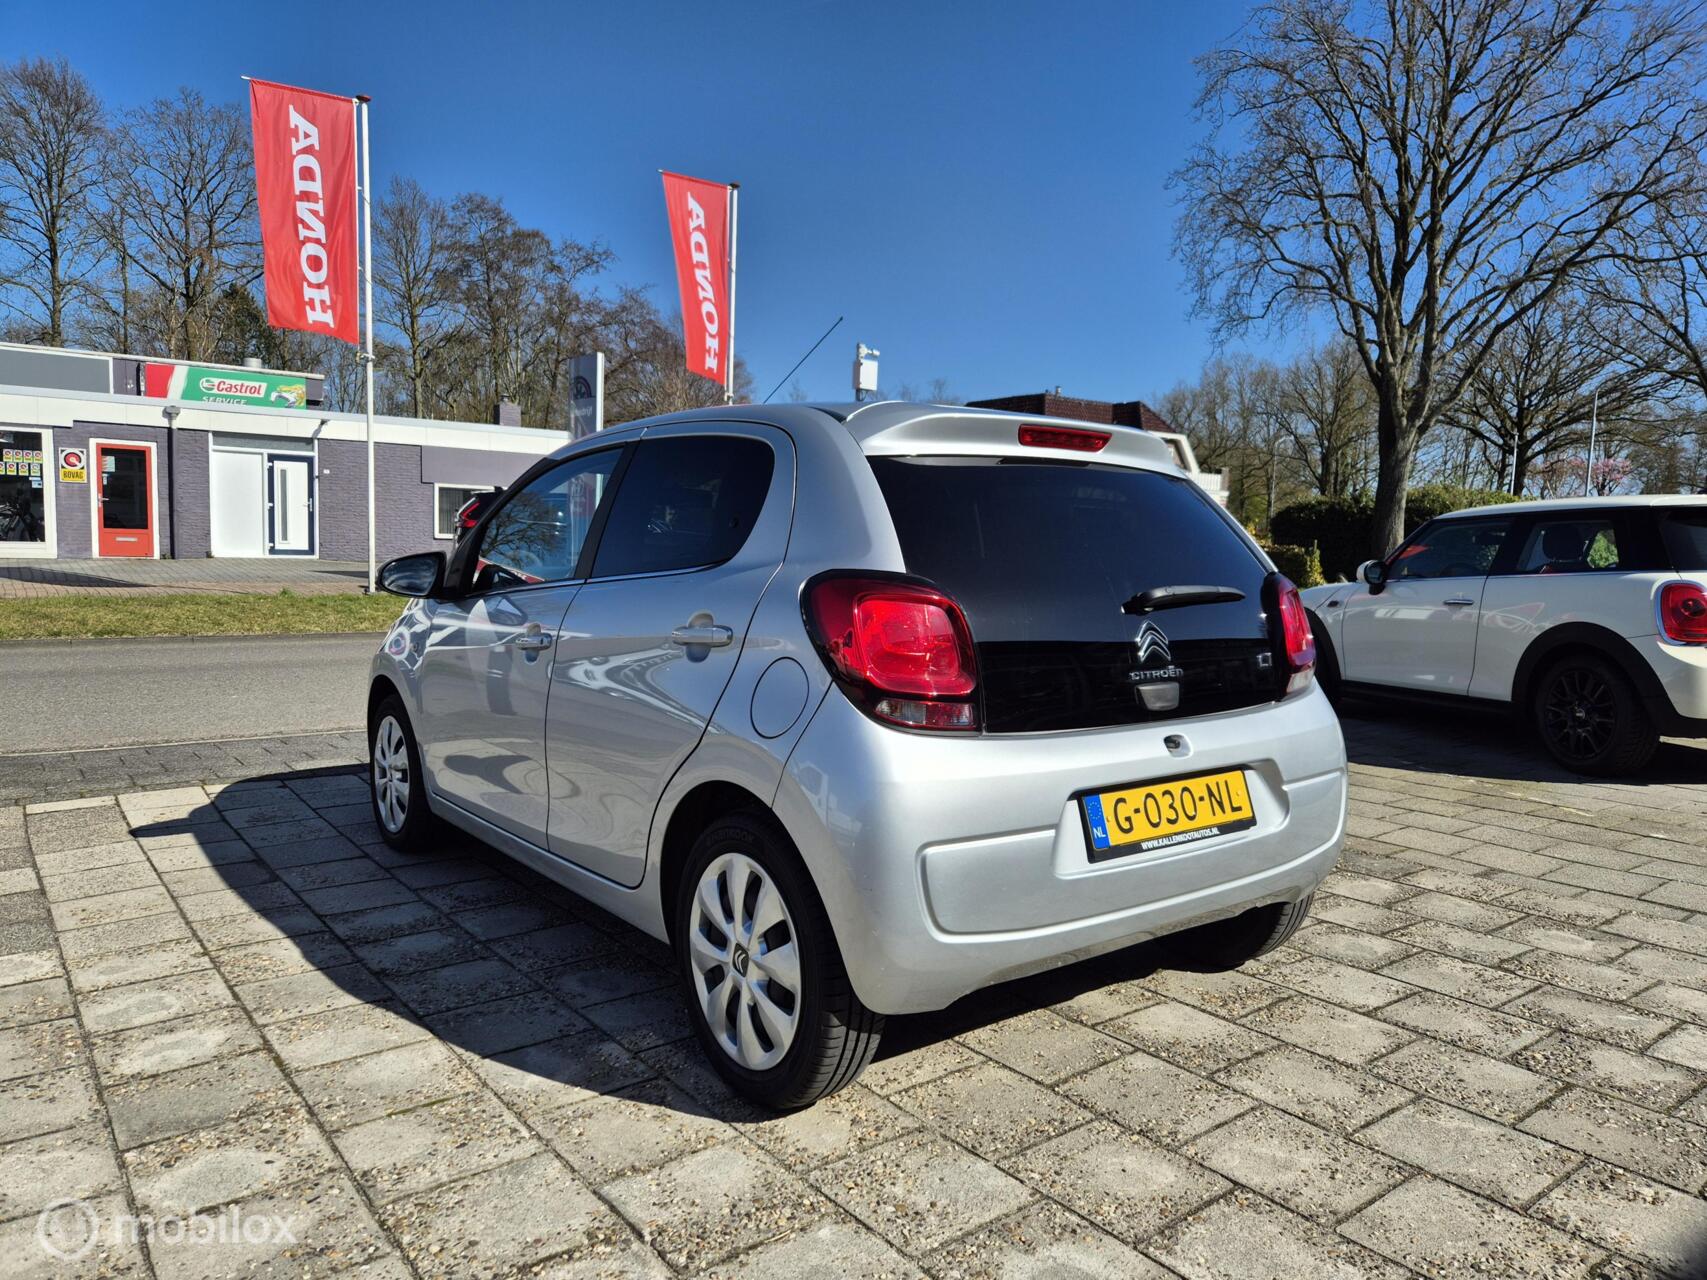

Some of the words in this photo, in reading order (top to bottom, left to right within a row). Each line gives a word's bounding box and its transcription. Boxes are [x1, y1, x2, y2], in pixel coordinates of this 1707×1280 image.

[216, 380, 262, 396] Castrol
[62, 470, 84, 480] BOVAG
[1113, 780, 1242, 834] G-030-NL
[1093, 826, 1106, 839] NL
